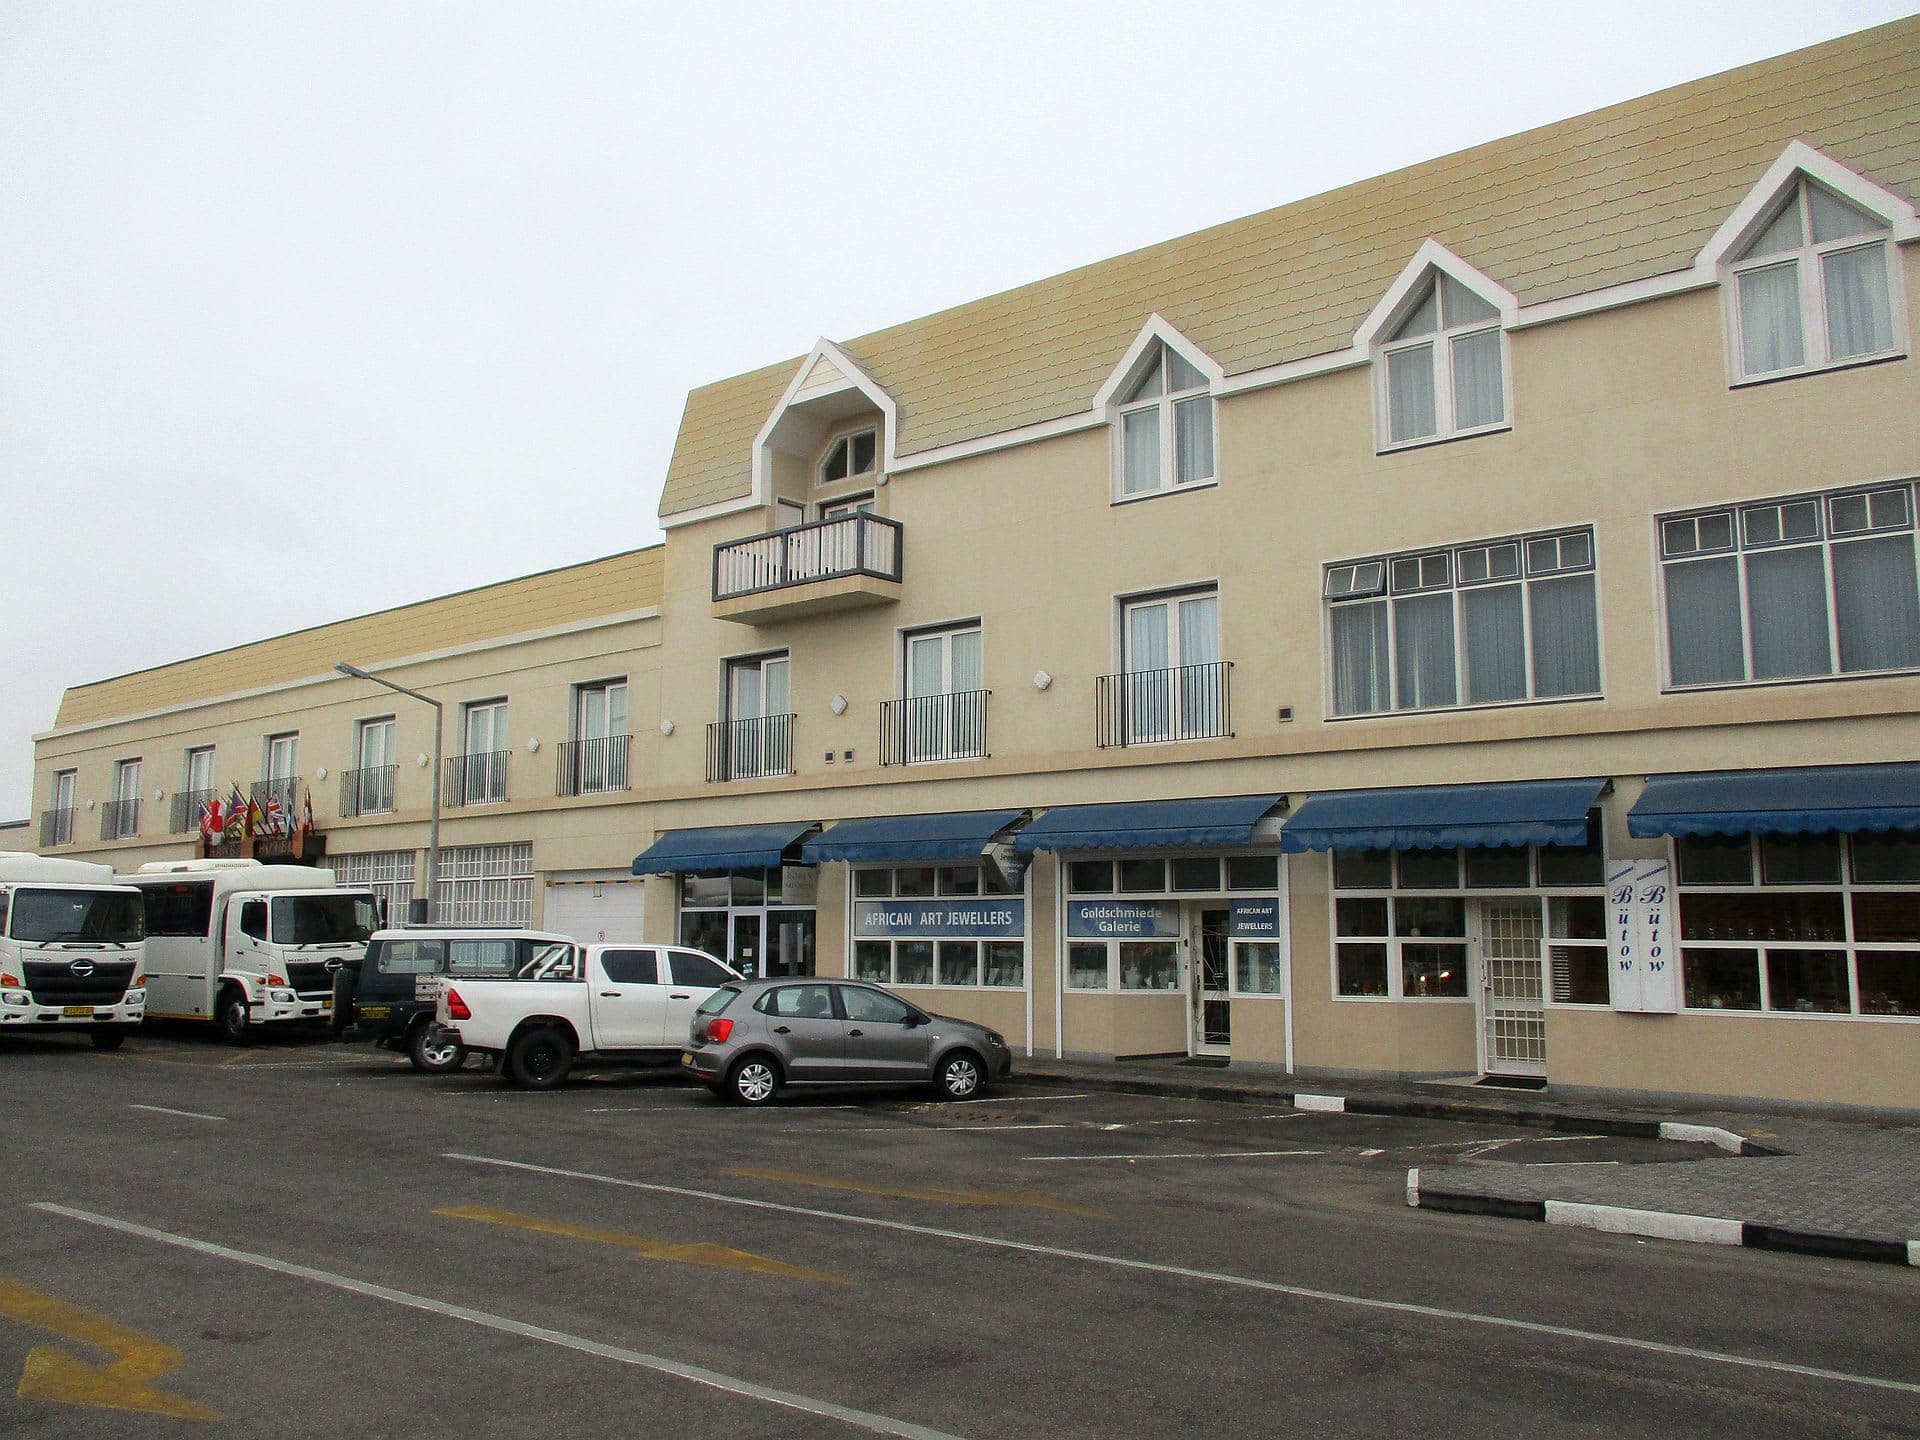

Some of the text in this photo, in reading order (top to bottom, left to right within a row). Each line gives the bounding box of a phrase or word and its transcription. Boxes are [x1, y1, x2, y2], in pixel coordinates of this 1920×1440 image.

[1080, 906, 1162, 919] Goldschmiede
[1236, 907, 1273, 915] AFRICAN ART
[865, 911, 1013, 926] AFRICAN ART JEWELLERS
[1099, 920, 1141, 932] Galerie
[1236, 921, 1273, 930] JEWELLERS
[1611, 884, 1633, 972] Bütow
[1640, 884, 1667, 972] Bütow
